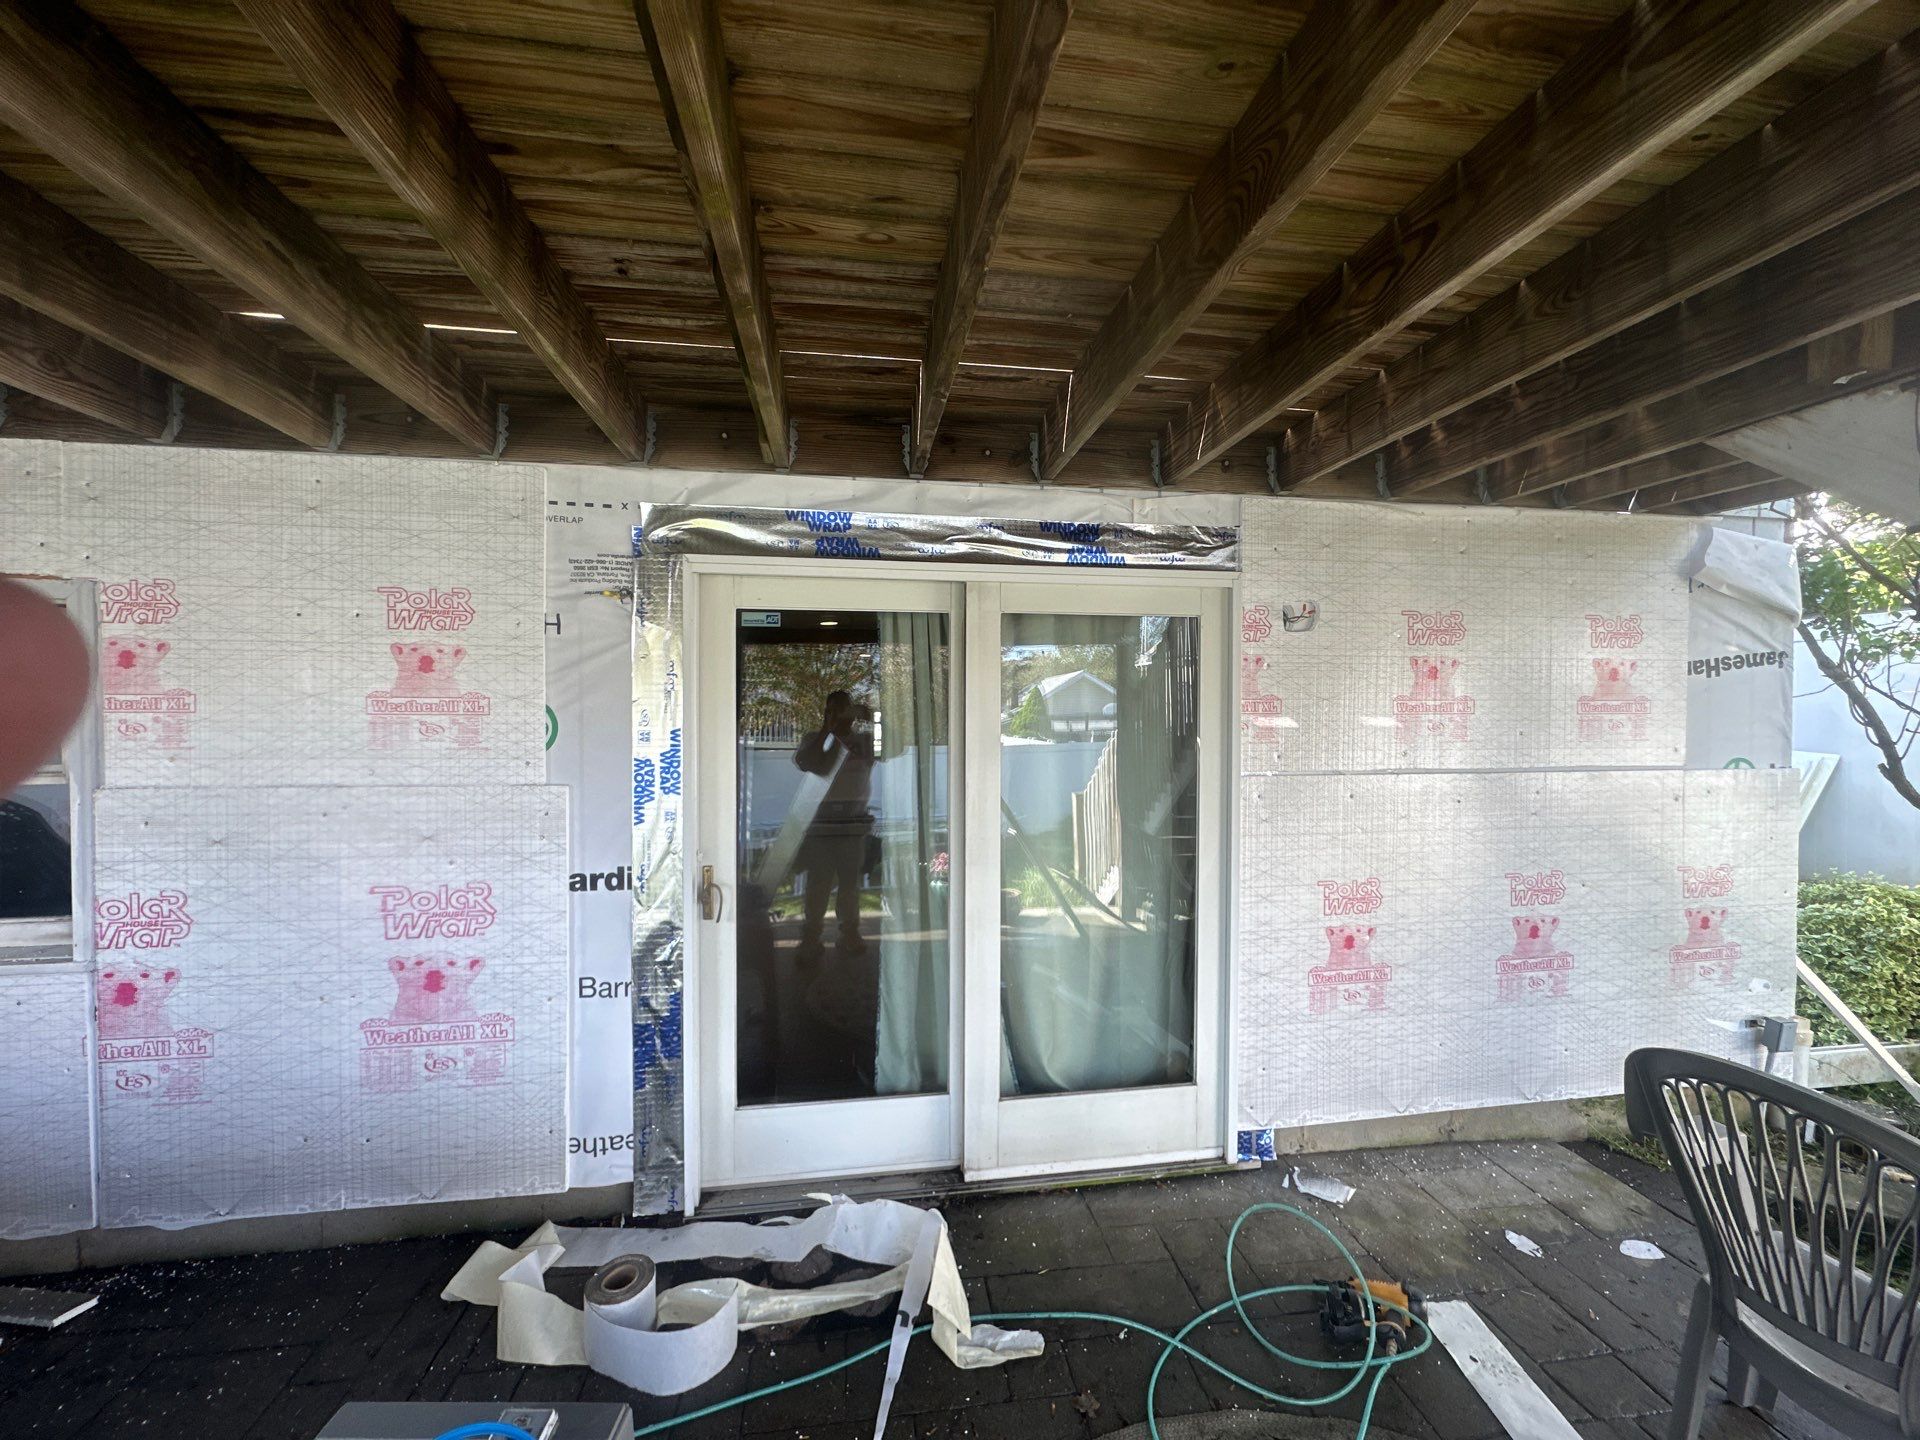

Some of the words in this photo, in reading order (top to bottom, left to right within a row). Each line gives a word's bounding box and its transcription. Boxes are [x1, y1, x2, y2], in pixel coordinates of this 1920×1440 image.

[786, 509, 853, 523] WINDOW
[808, 520, 853, 533] WRAP
[1039, 521, 1100, 535] WINDOW
[814, 547, 881, 559] WINDOW
[1066, 554, 1127, 566] WINDOW
[463, 700, 485, 713] XL
[670, 728, 682, 796] WINDOW
[644, 758, 656, 804] WRAP
[660, 751, 671, 796] WRAP
[634, 757, 645, 826] WINDOW
[569, 866, 633, 892] ardi
[125, 920, 159, 928] HOUSE
[578, 976, 633, 999] Barr
[364, 1024, 476, 1047] WeatherAll
[480, 1022, 508, 1039] XL
[177, 1039, 207, 1056] XL
